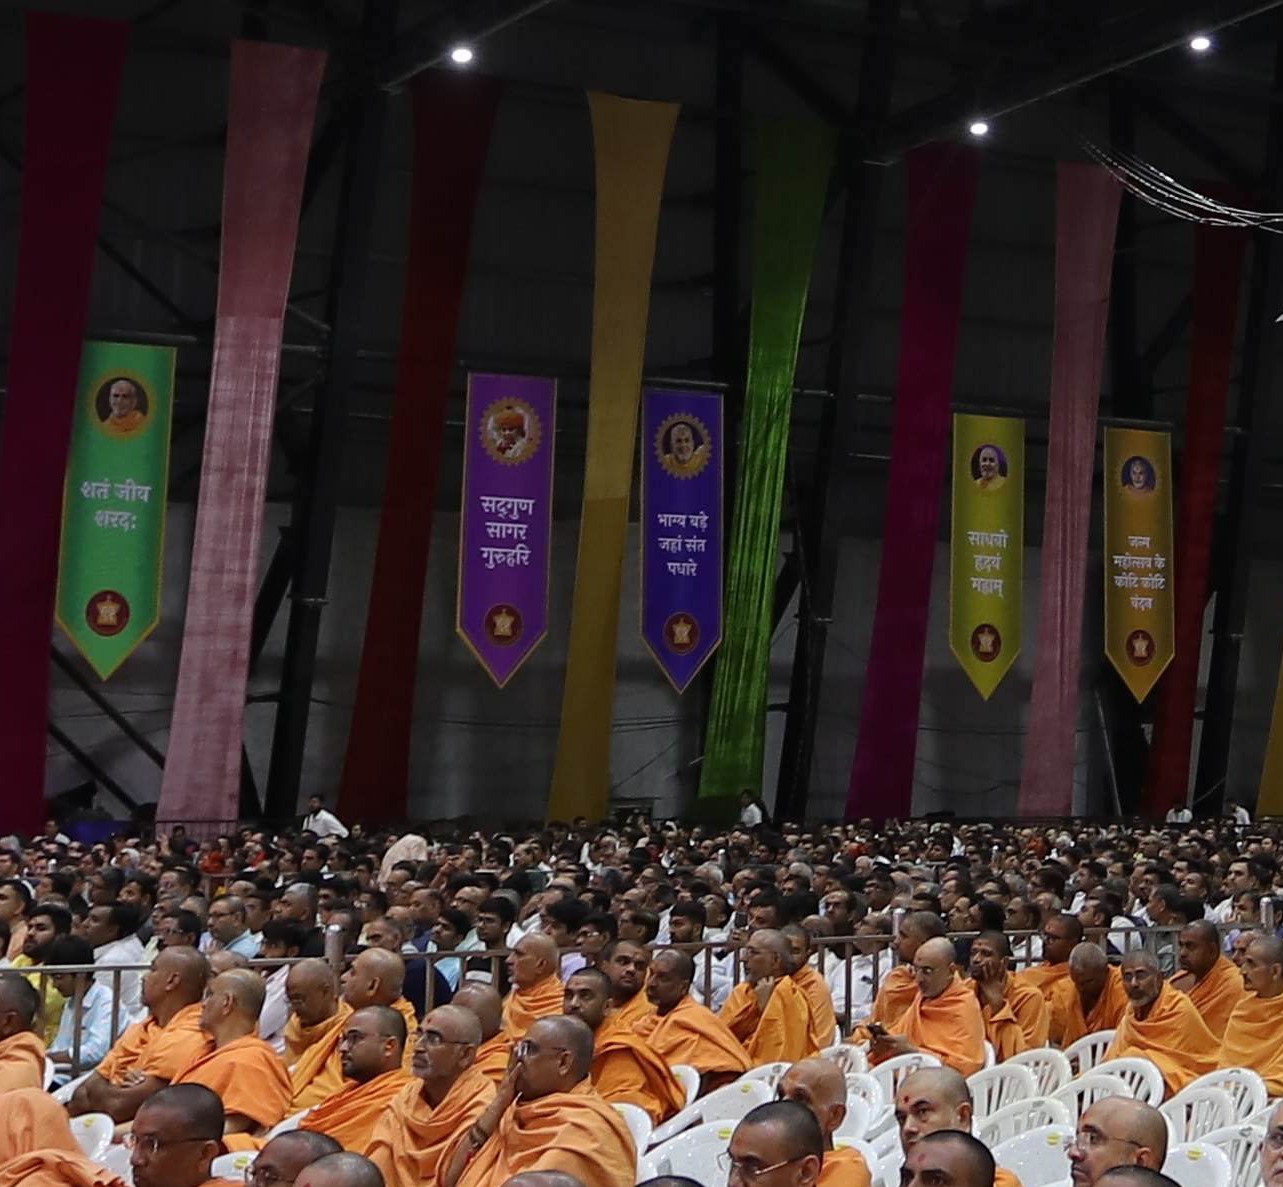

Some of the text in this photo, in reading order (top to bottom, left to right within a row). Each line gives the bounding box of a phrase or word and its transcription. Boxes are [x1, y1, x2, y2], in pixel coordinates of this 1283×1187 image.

[80, 478, 153, 502] शतं जीव
[480, 495, 535, 521] सद्गुण
[94, 508, 137, 532] शरदः
[657, 511, 709, 533] भाग्य बड़े
[485, 522, 528, 540] सागर
[658, 535, 706, 553] जहां संत
[1128, 535, 1151, 549] जन्म
[480, 544, 531, 569] गुरुहरि
[1112, 553, 1166, 570] महोत्सव के
[667, 559, 698, 577] पधारे
[1113, 574, 1166, 591] कोटि कोटि
